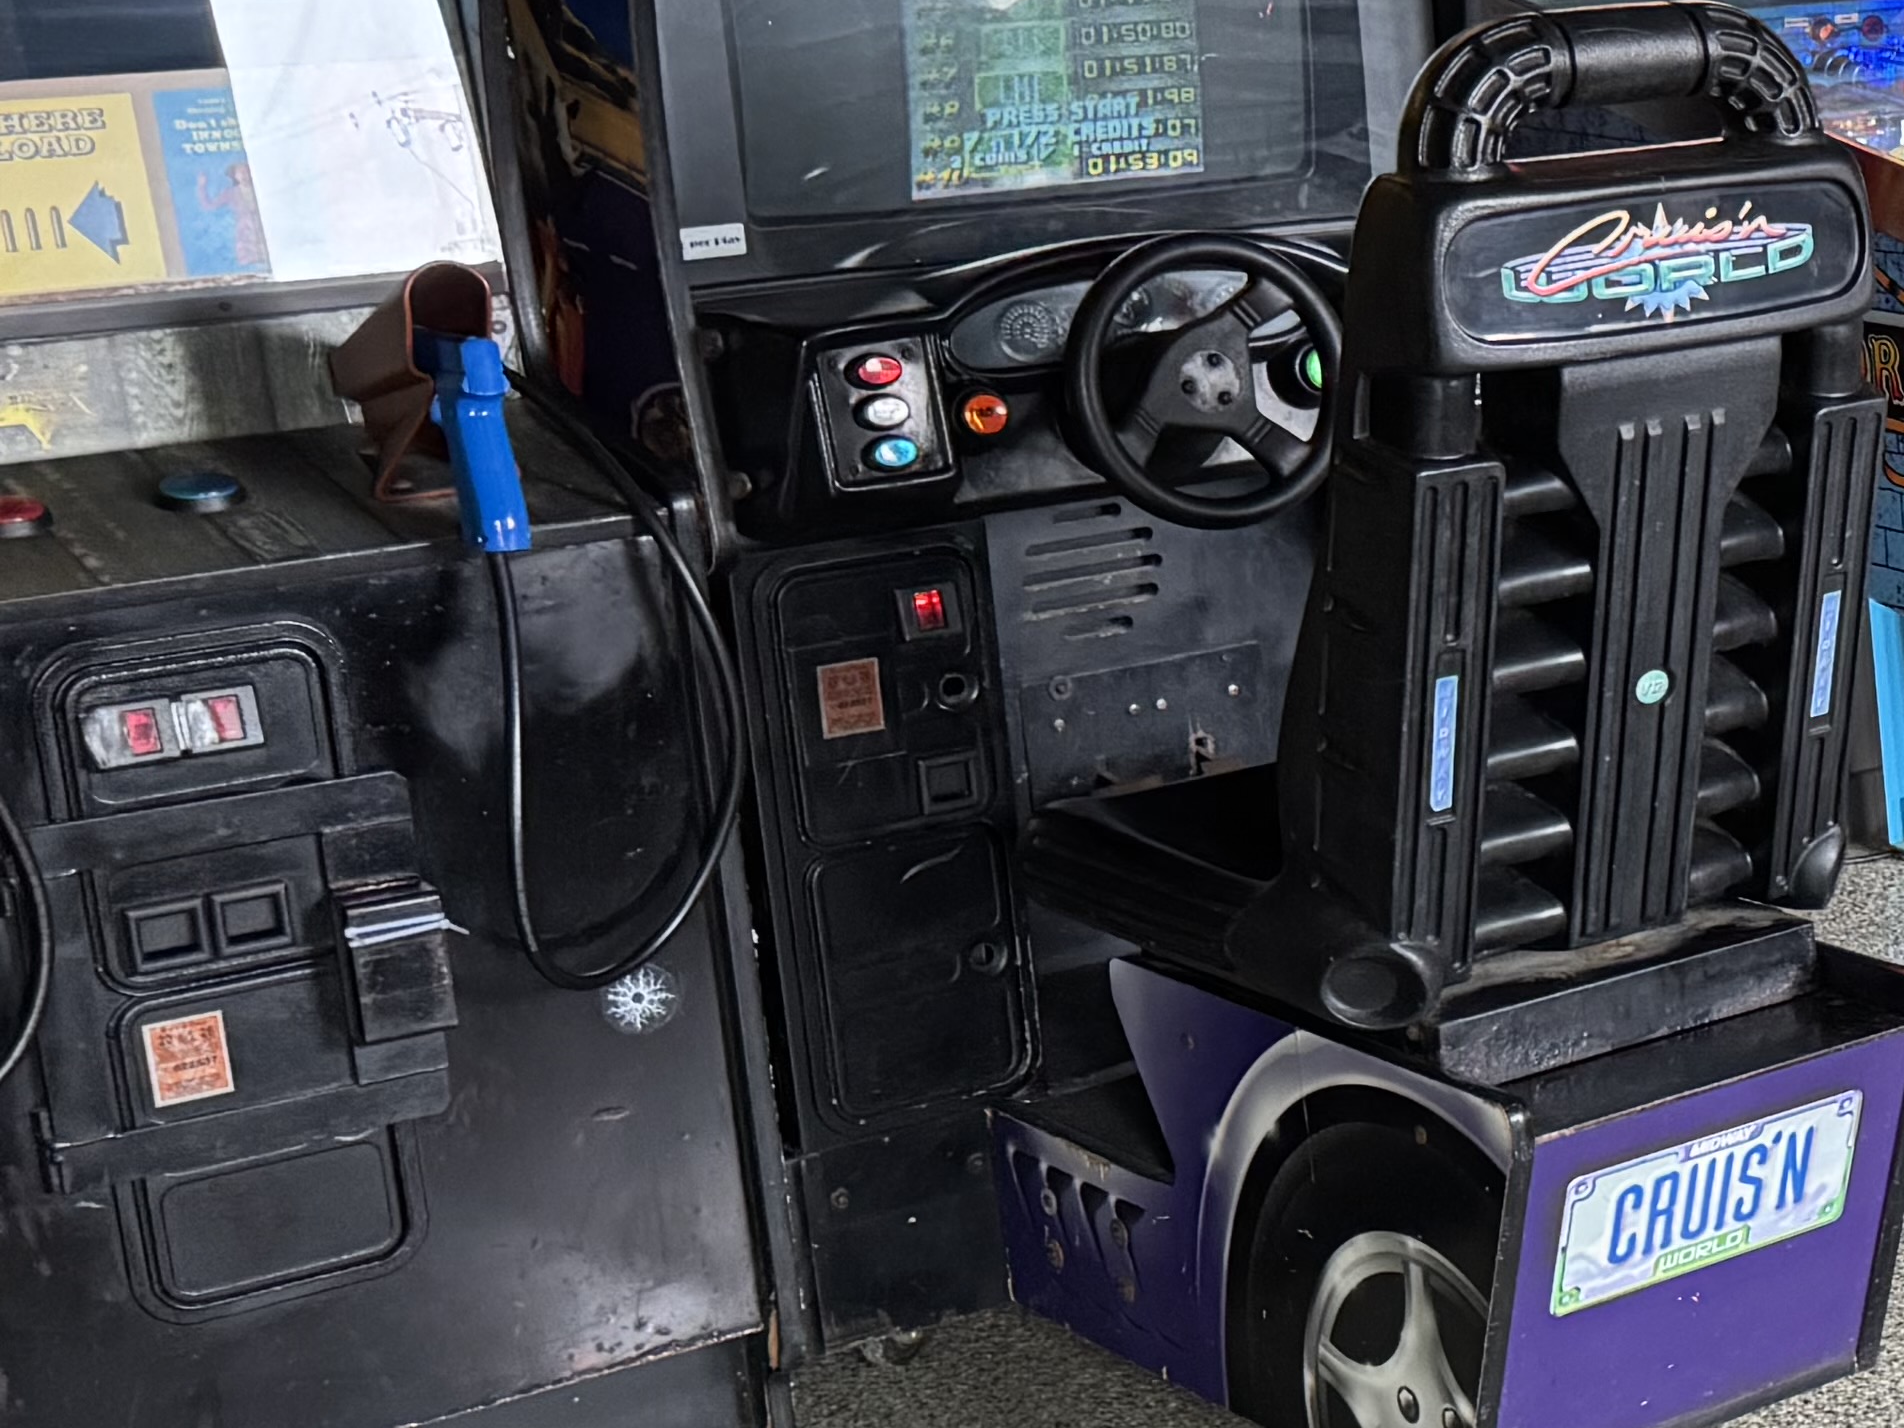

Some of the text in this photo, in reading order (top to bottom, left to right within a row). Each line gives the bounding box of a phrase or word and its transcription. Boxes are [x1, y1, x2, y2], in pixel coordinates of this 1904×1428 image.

[984, 105, 1062, 126] PRESS
[1070, 95, 1141, 118] START
[1069, 119, 1155, 140] CREDITS
[1087, 149, 1199, 176] 01:53:09
[1501, 232, 1815, 304] WORLD
[1607, 1125, 1815, 1265] CRUIS'N
[1658, 1229, 1746, 1270] WORLD
